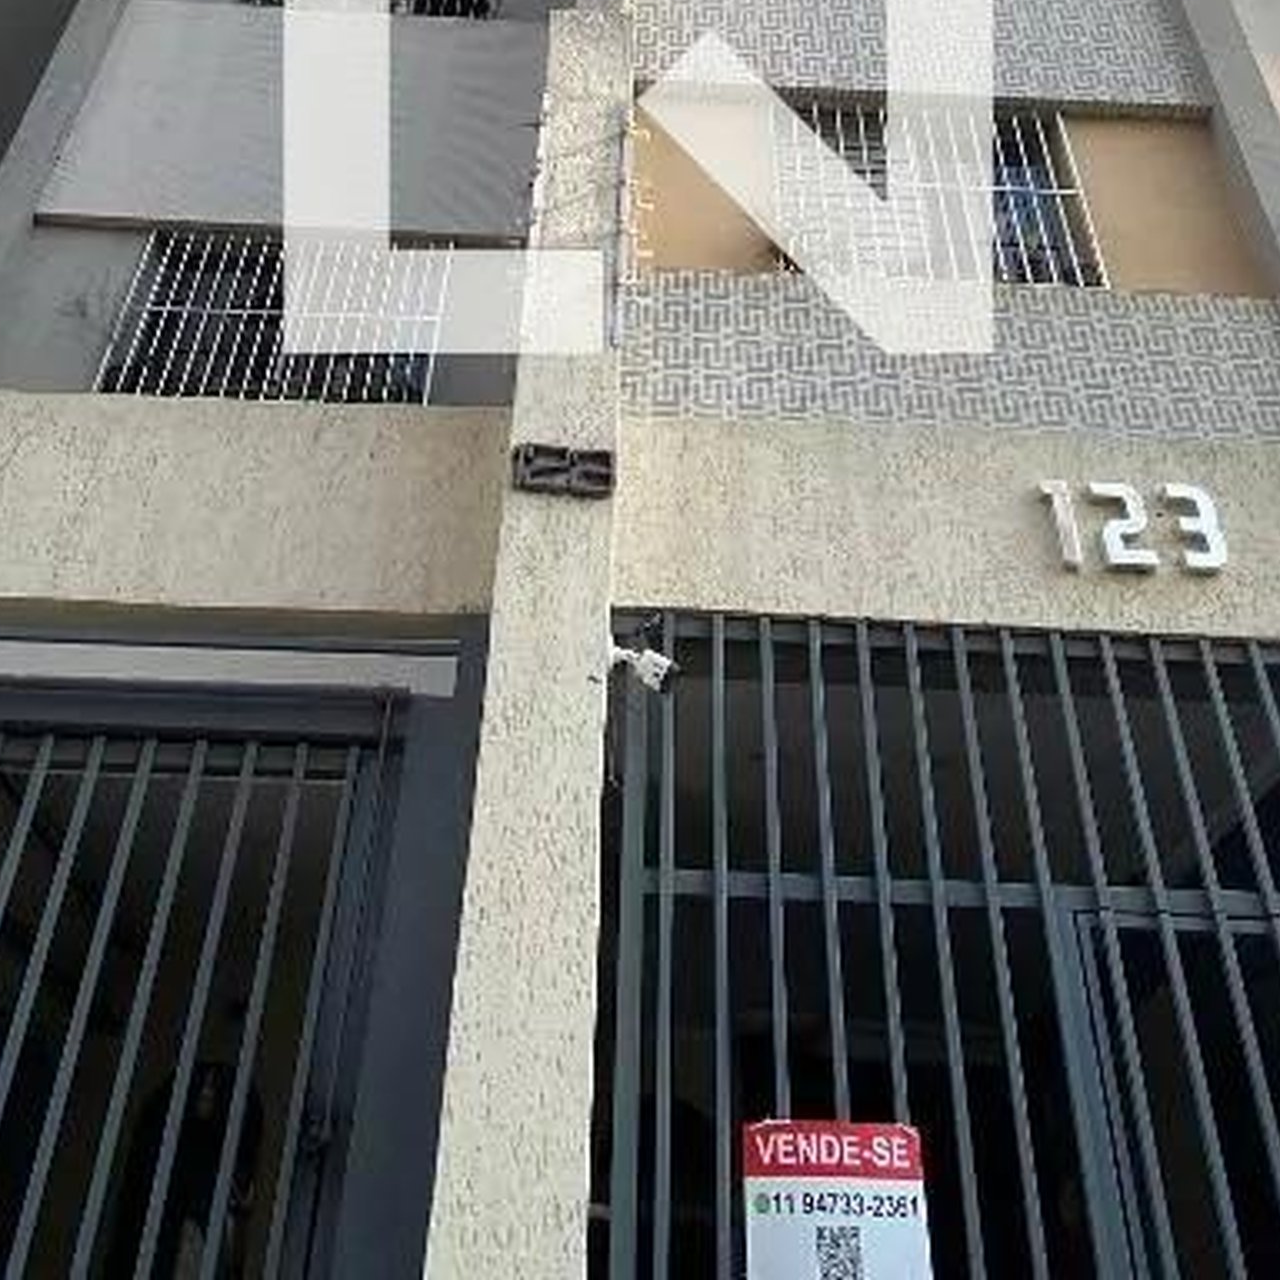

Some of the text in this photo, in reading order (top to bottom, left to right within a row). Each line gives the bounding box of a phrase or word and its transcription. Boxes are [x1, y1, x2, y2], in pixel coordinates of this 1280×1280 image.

[1039, 479, 1228, 569] 123
[755, 1133, 911, 1168] VENDE-SE
[772, 1192, 795, 1214] 11
